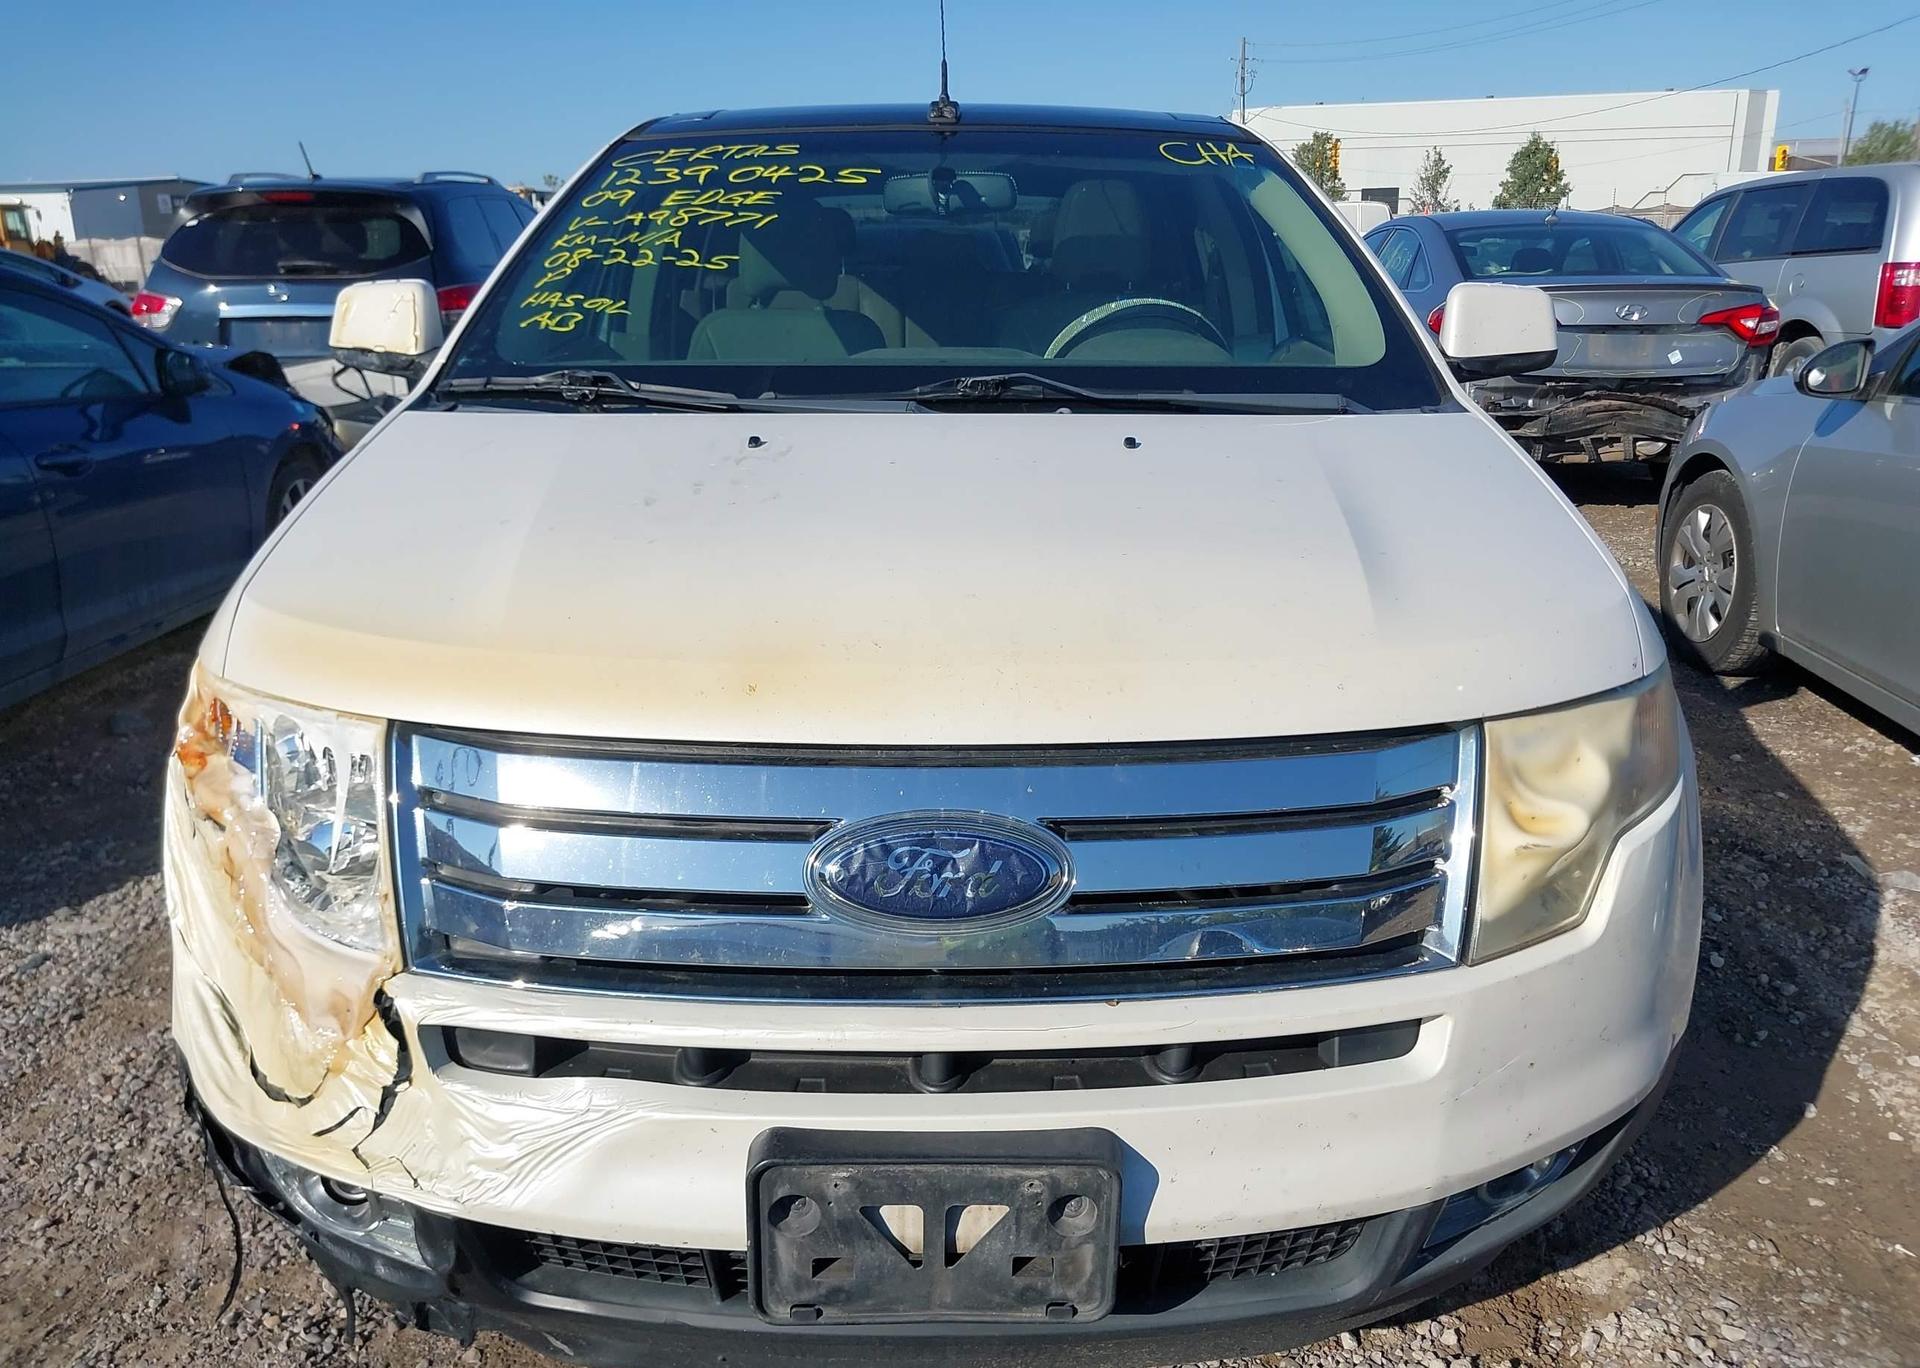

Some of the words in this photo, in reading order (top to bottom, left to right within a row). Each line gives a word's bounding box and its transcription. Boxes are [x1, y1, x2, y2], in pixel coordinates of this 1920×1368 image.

[581, 190, 636, 208] 09
[660, 188, 783, 207] EDGE
[543, 248, 741, 270] 08-22-25
[873, 845, 1003, 898] Ford
